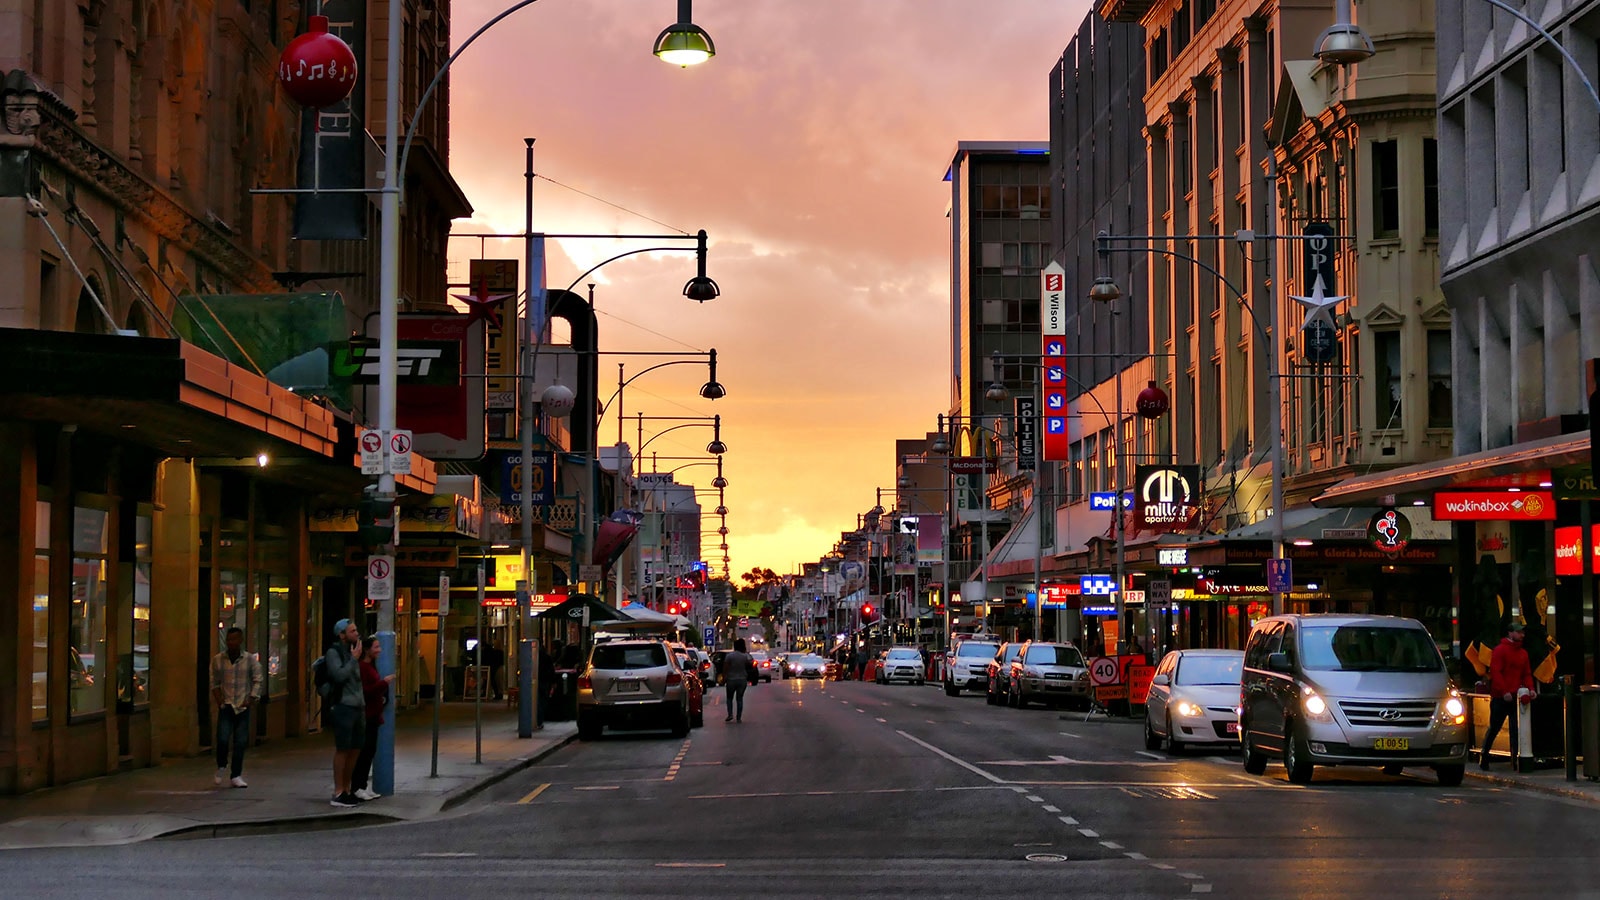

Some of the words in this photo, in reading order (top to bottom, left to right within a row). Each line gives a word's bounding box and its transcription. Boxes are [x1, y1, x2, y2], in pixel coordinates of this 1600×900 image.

[1051, 293, 1059, 329] Wilson
[1021, 402, 1033, 455] POLITES
[1051, 420, 1061, 431] P
[507, 456, 548, 464] GOEN
[511, 493, 544, 501] CIN
[1094, 496, 1131, 507] Polie
[1446, 499, 1509, 512] wokinabox
[1145, 516, 1188, 524] apartts
[1095, 664, 1114, 677] 40
